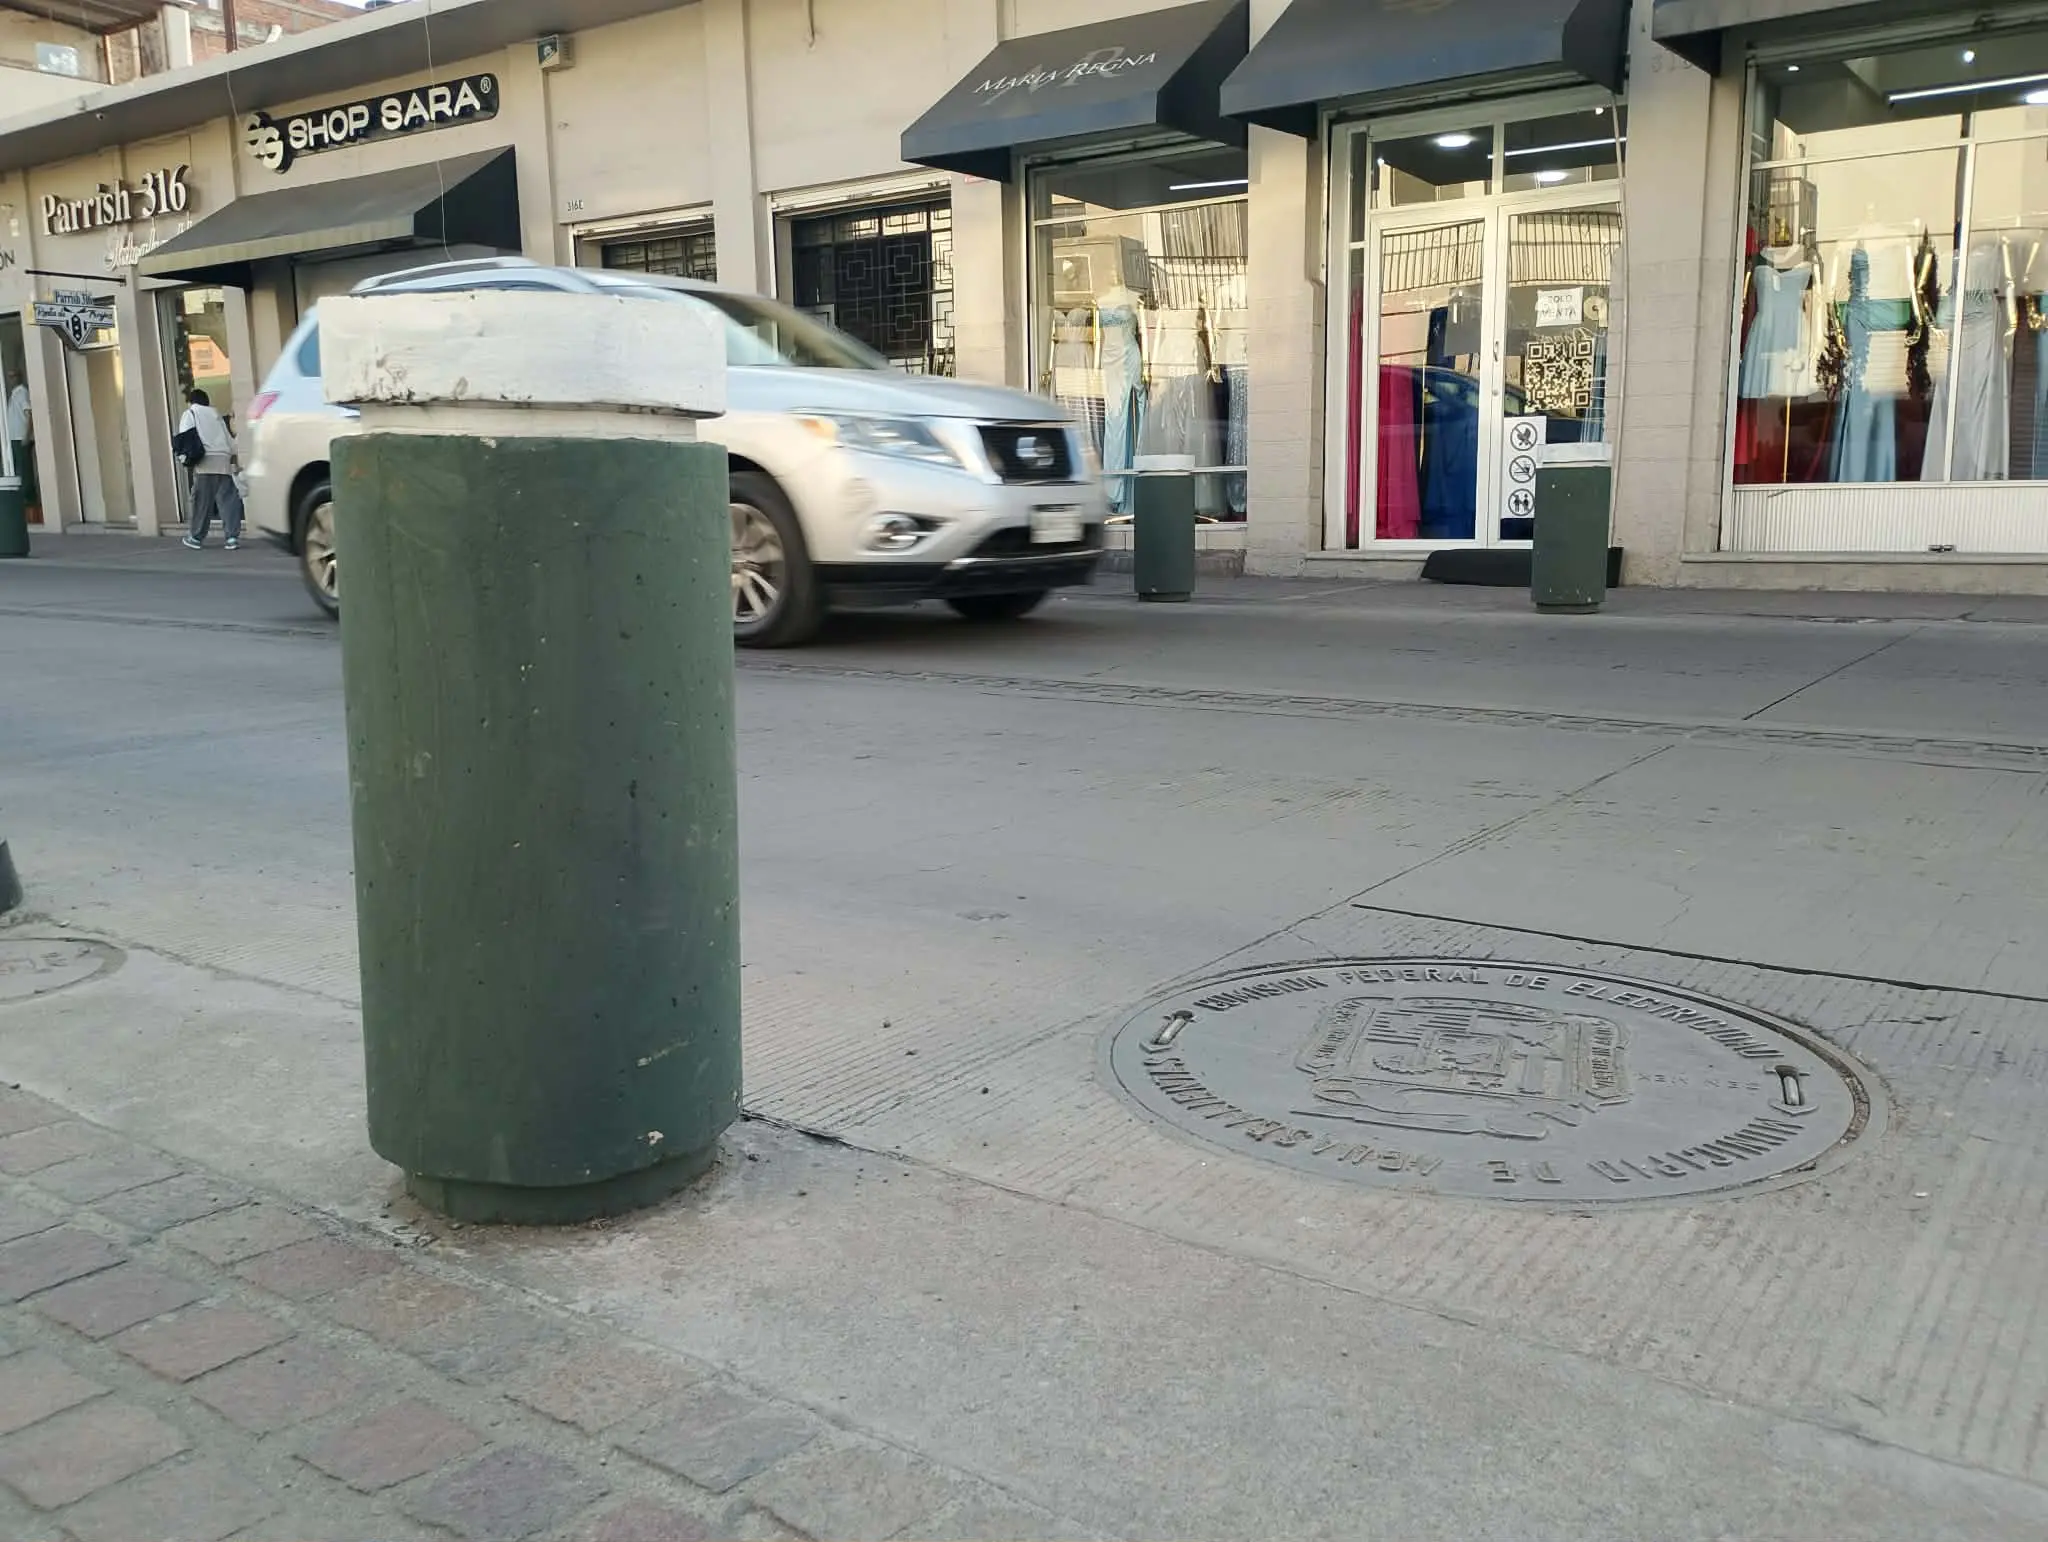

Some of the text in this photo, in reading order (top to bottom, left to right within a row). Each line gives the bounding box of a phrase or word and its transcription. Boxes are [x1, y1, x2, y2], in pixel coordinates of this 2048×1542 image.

[972, 51, 1157, 94] MARIA REGNA
[288, 105, 370, 150] SHOP
[41, 164, 190, 236] Parrish 316
[1193, 975, 1329, 1012] COMISION
[1336, 966, 1489, 984] FEDERAL
[1503, 973, 1551, 990] DE
[1564, 980, 1785, 1058] ELECTRICIDAD
[1482, 1158, 1563, 1184] DE
[1586, 1116, 1806, 1183] MUNICIPIO
